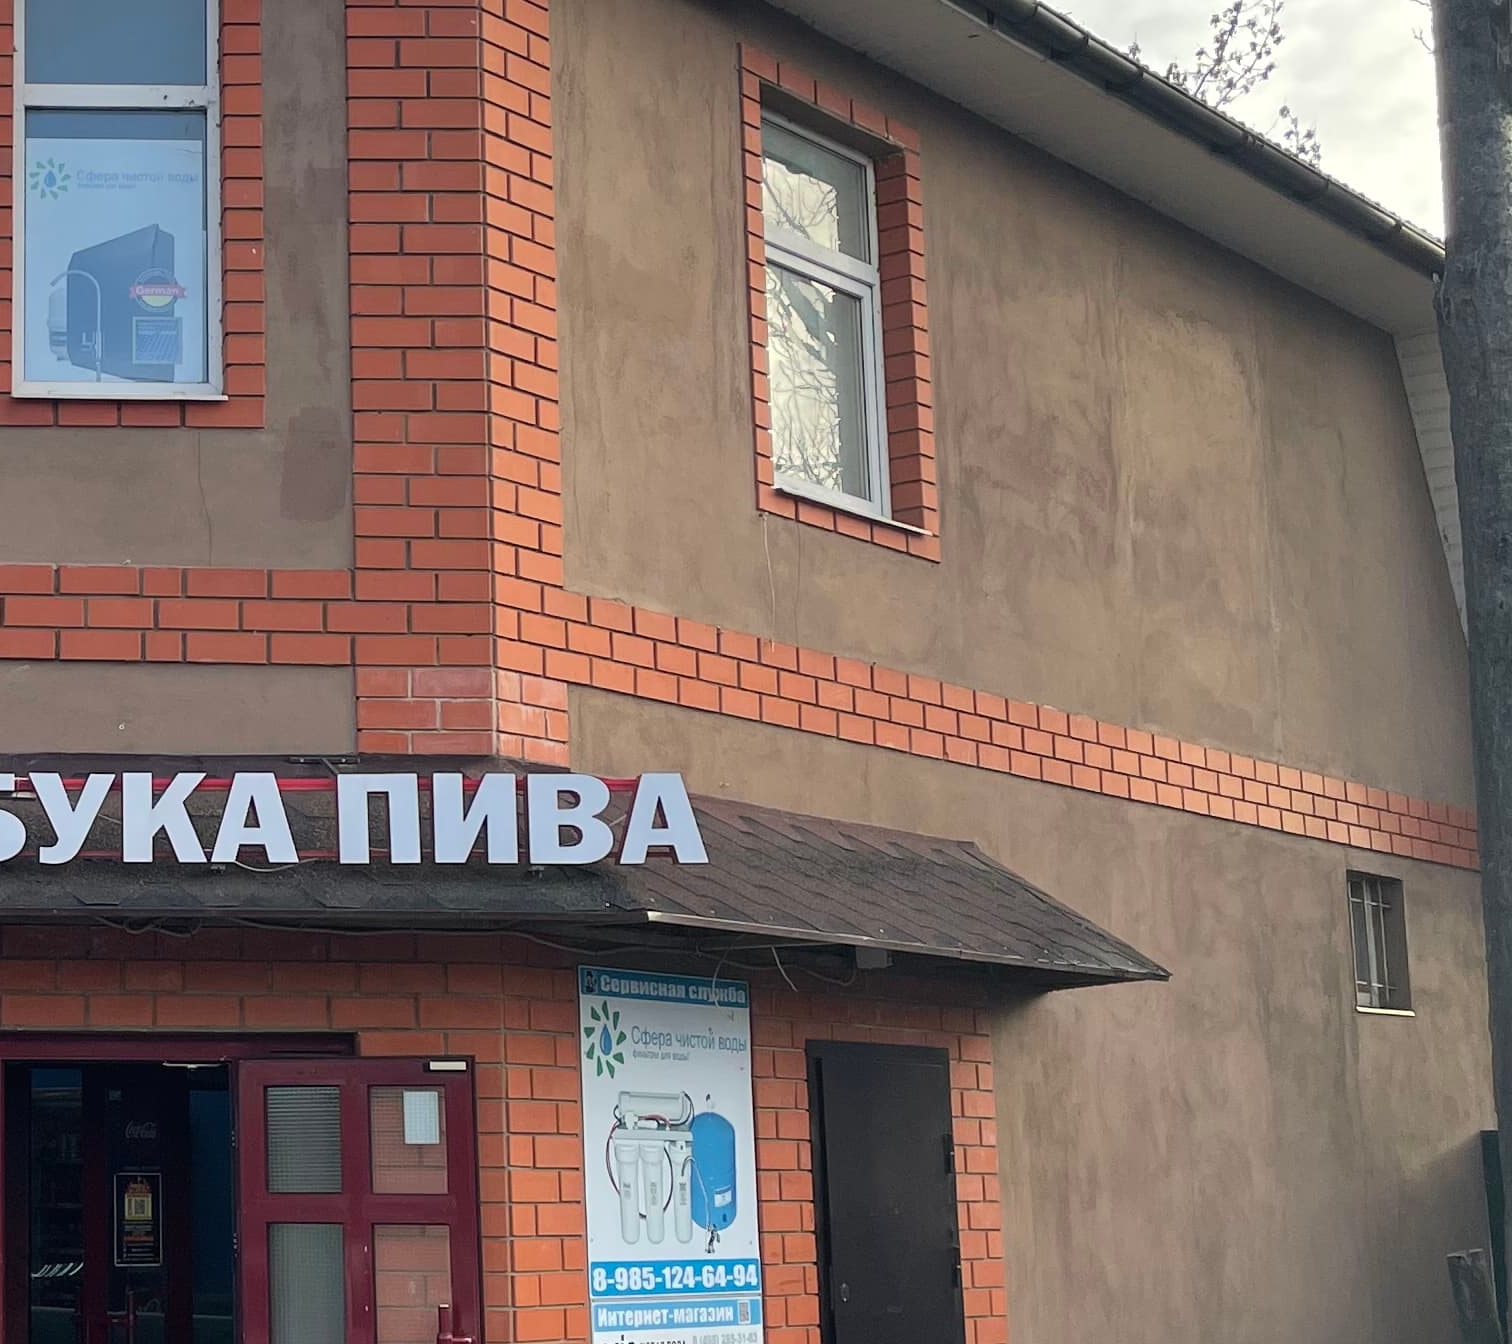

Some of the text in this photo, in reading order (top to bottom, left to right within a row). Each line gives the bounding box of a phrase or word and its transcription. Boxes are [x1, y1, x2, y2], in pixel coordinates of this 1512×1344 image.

[337, 771, 709, 866] ПИВА
[600, 974, 687, 1000] Сервисная
[631, 1025, 747, 1054] Сфера чистой воды
[592, 1263, 758, 1292] 8-985-124-64-94
[597, 1305, 734, 1328] Интернет-магазин
